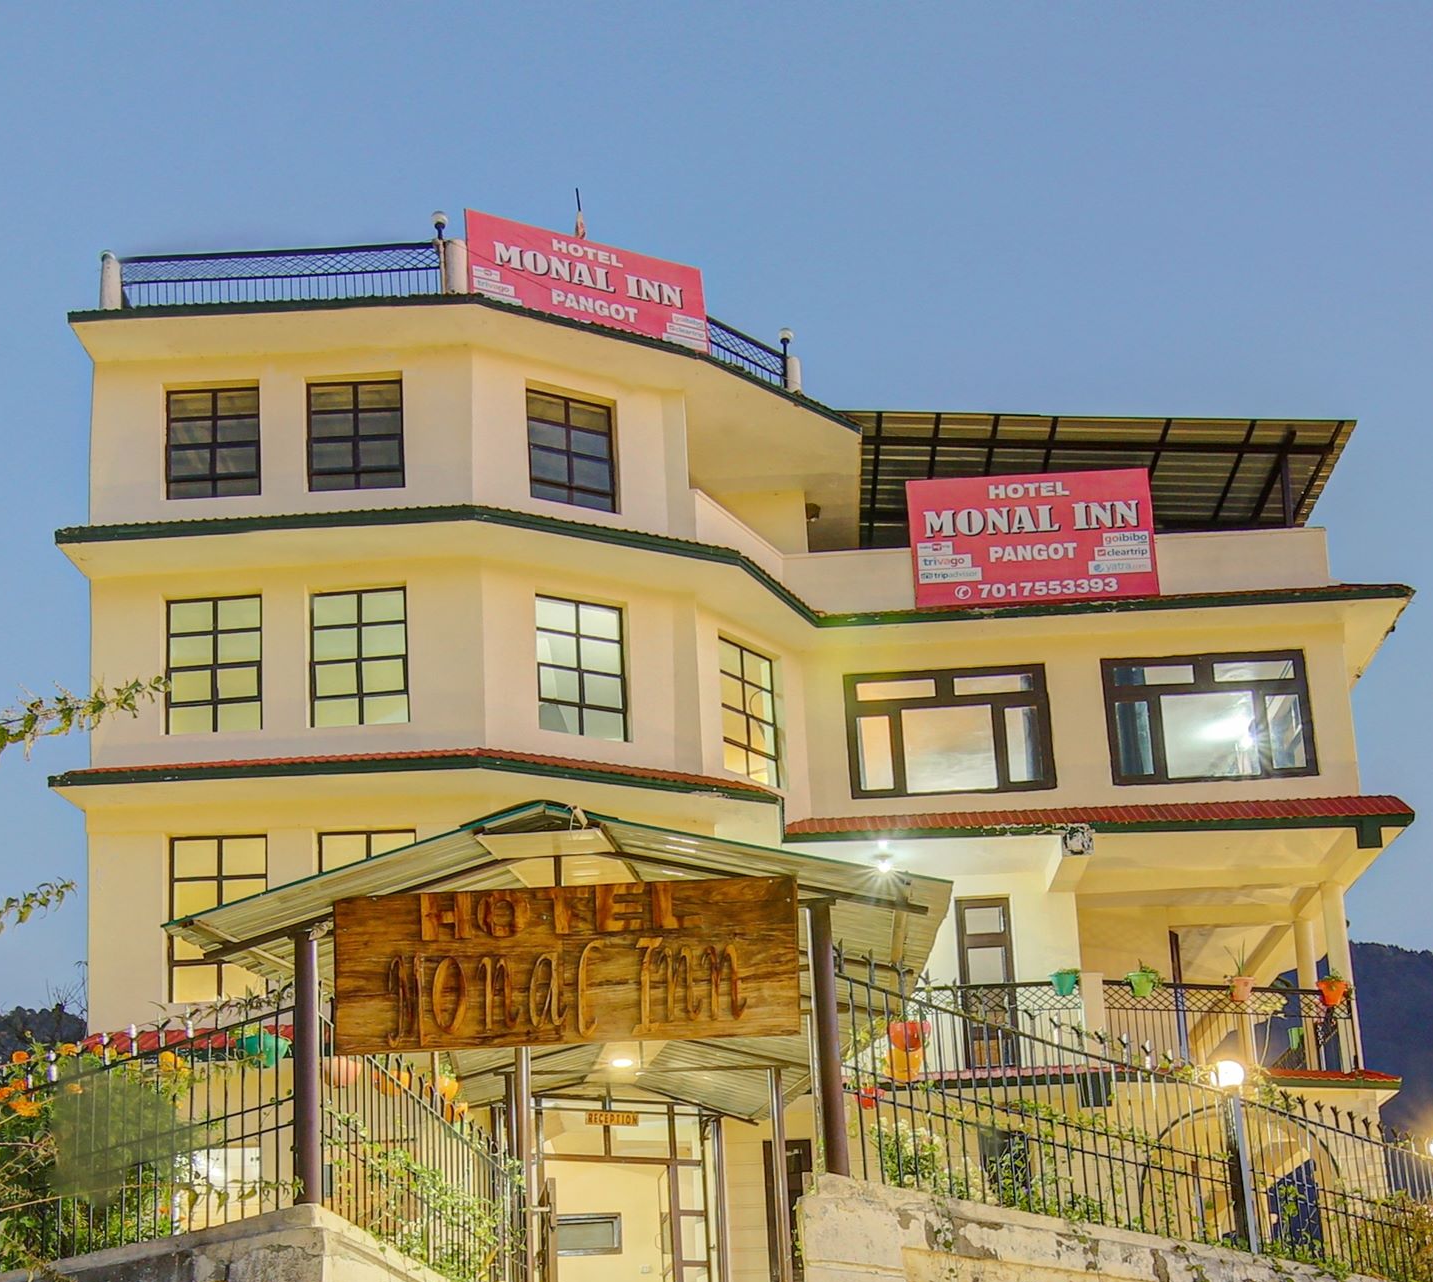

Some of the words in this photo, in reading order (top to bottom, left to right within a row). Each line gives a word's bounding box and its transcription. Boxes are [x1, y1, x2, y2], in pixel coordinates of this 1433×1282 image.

[551, 238, 624, 268] HOTEL
[493, 241, 615, 293] MONAL
[625, 274, 684, 309] INN
[551, 288, 638, 323] PANGOT
[988, 481, 1070, 500] HOTEL
[923, 505, 1062, 538] MONAL
[1071, 500, 1139, 531] INN
[1104, 533, 1147, 545] goibibo
[923, 557, 965, 567] trivago
[989, 542, 1077, 563] PANGOT
[1107, 547, 1148, 557] cleartrip
[978, 577, 1119, 599] 7017553393
[419, 881, 703, 942] HOTEL
[632, 936, 748, 1036] Inn
[587, 1112, 639, 1125] RECEPTION
